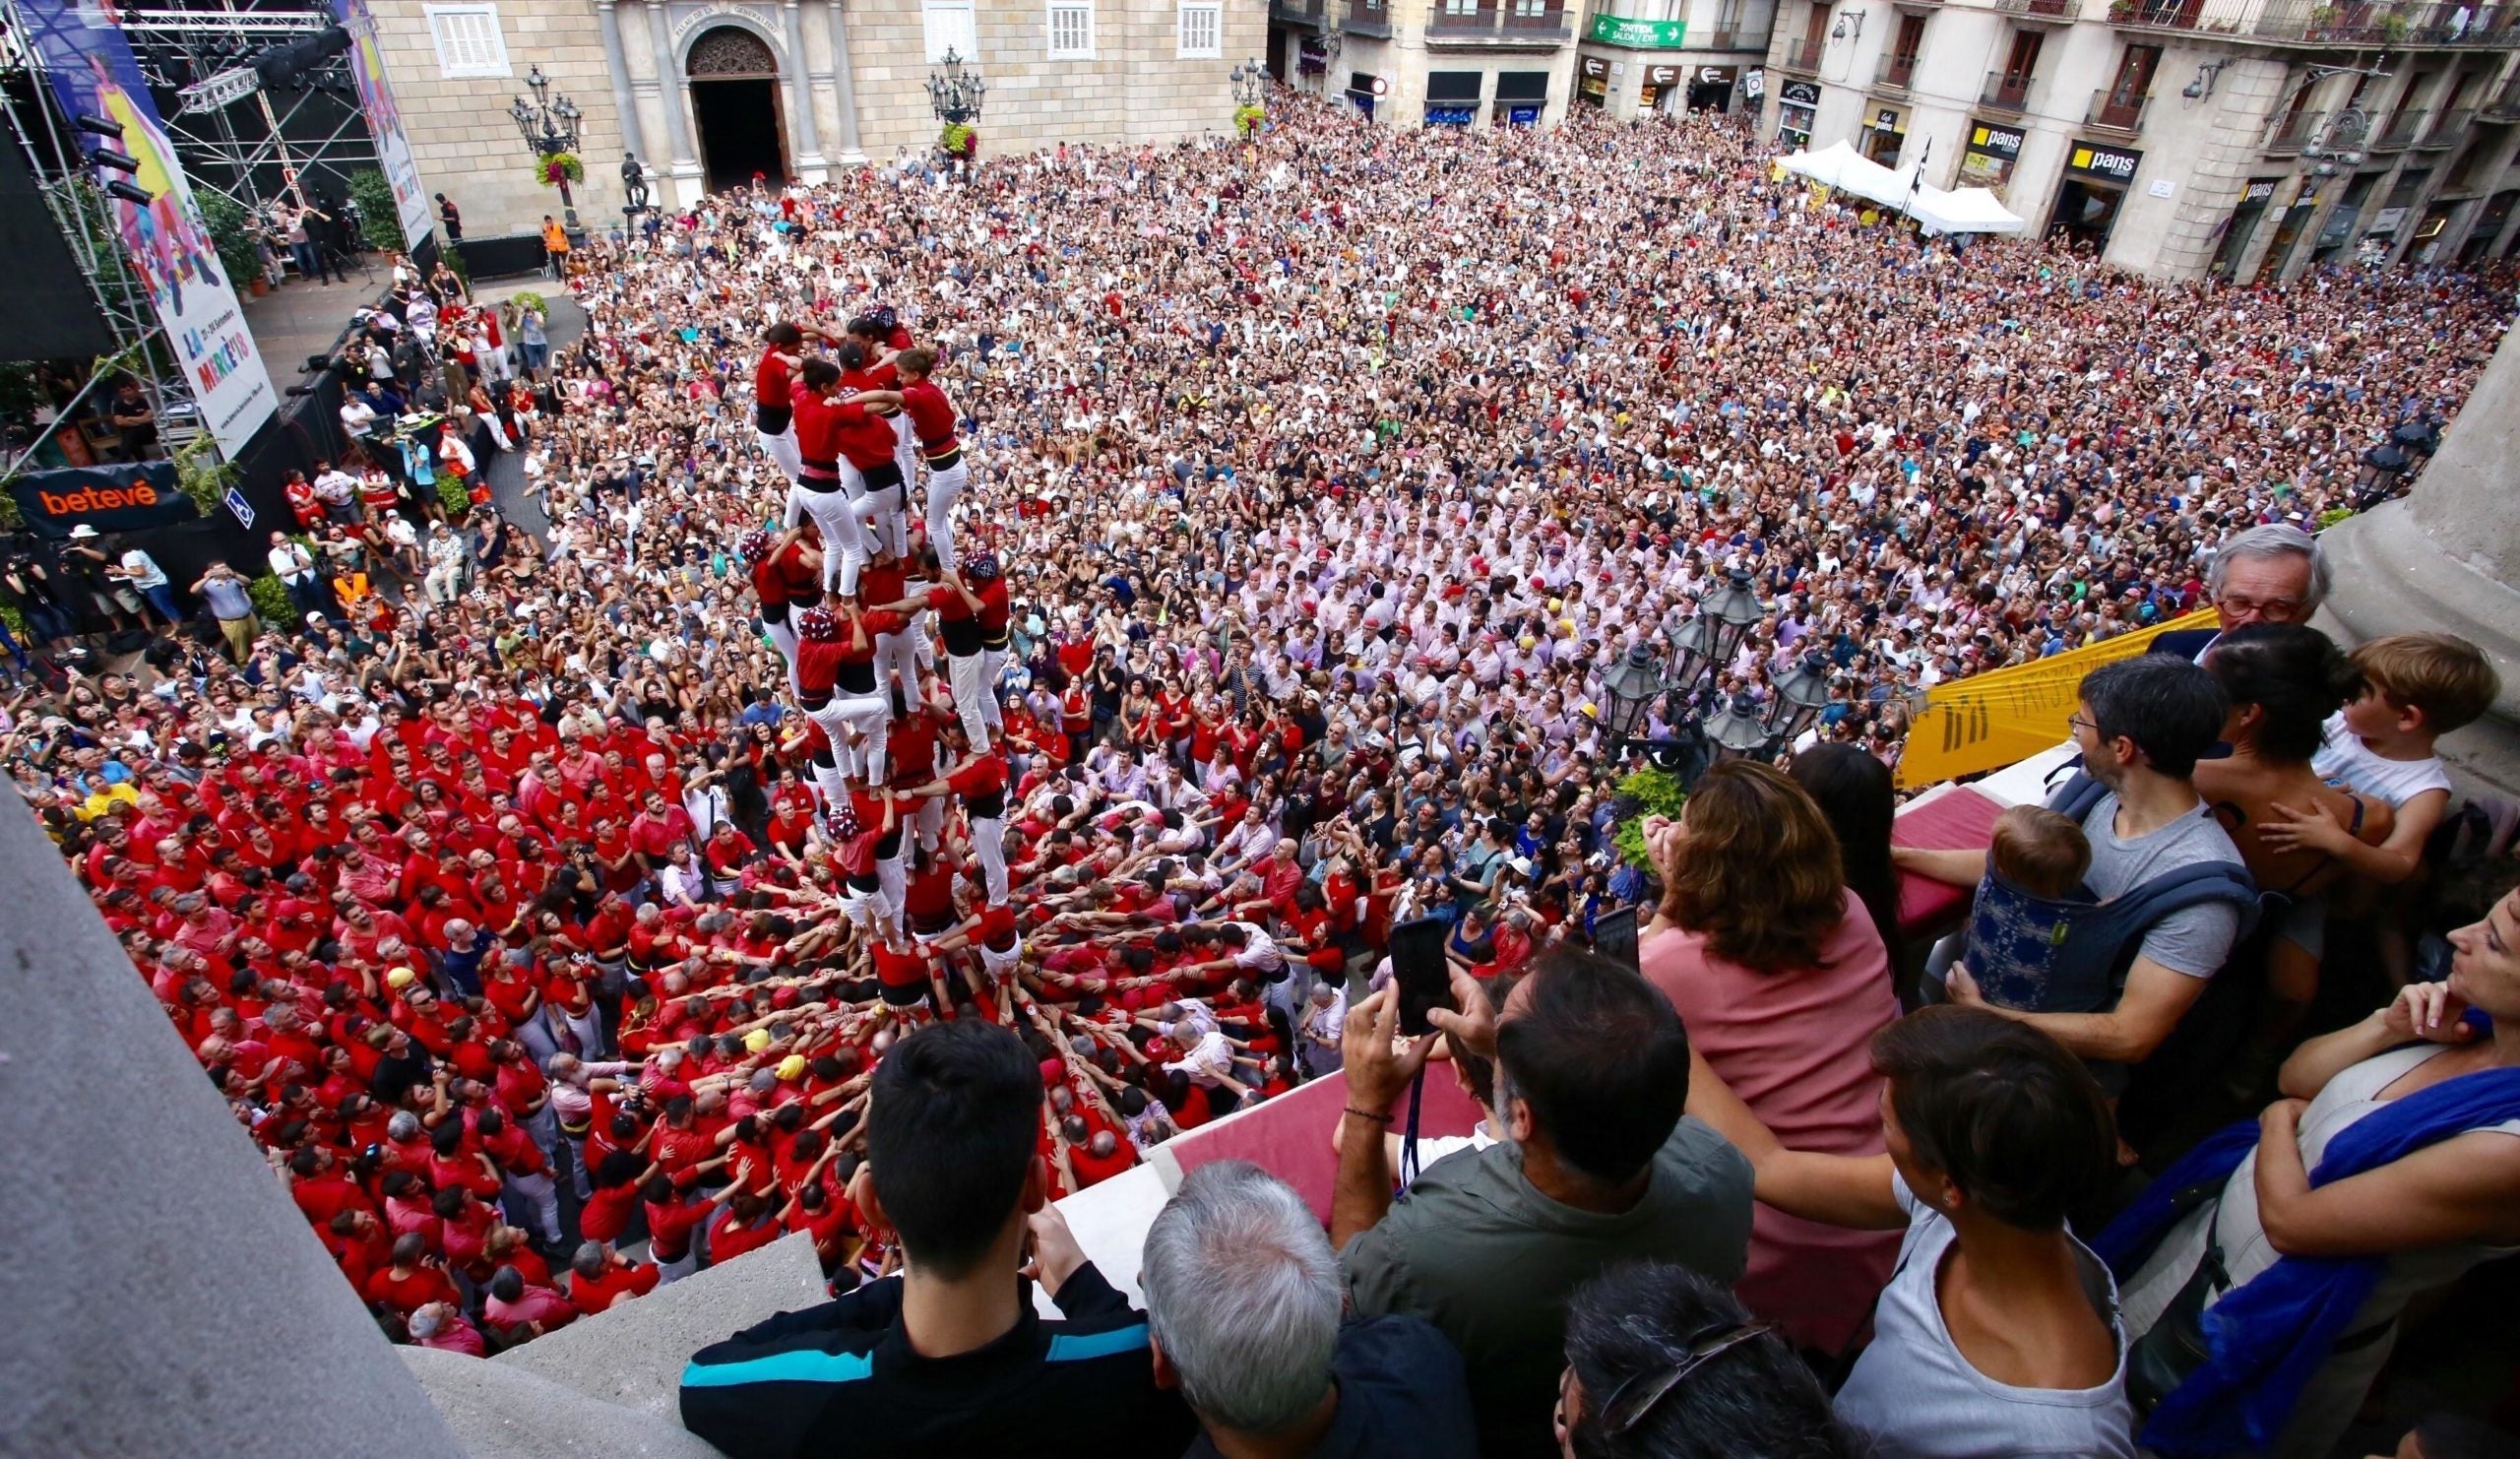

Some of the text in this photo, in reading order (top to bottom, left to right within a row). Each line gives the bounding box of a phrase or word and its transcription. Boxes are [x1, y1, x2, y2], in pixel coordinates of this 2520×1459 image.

[675, 16, 694, 36] PALAU
[693, 8, 704, 20] DE
[1618, 22, 1654, 34] SORTIDA
[1611, 31, 1635, 42] SALIDA
[1642, 33, 1660, 43] EXIT
[1786, 83, 1815, 101] BARCELONA
[1874, 121, 1893, 132] pans
[1986, 130, 2021, 149] pans
[2091, 152, 2135, 171] pans
[2244, 182, 2275, 203] pans
[2295, 197, 2313, 209] pans
[183, 326, 205, 361] LA
[39, 478, 158, 516] betevé
